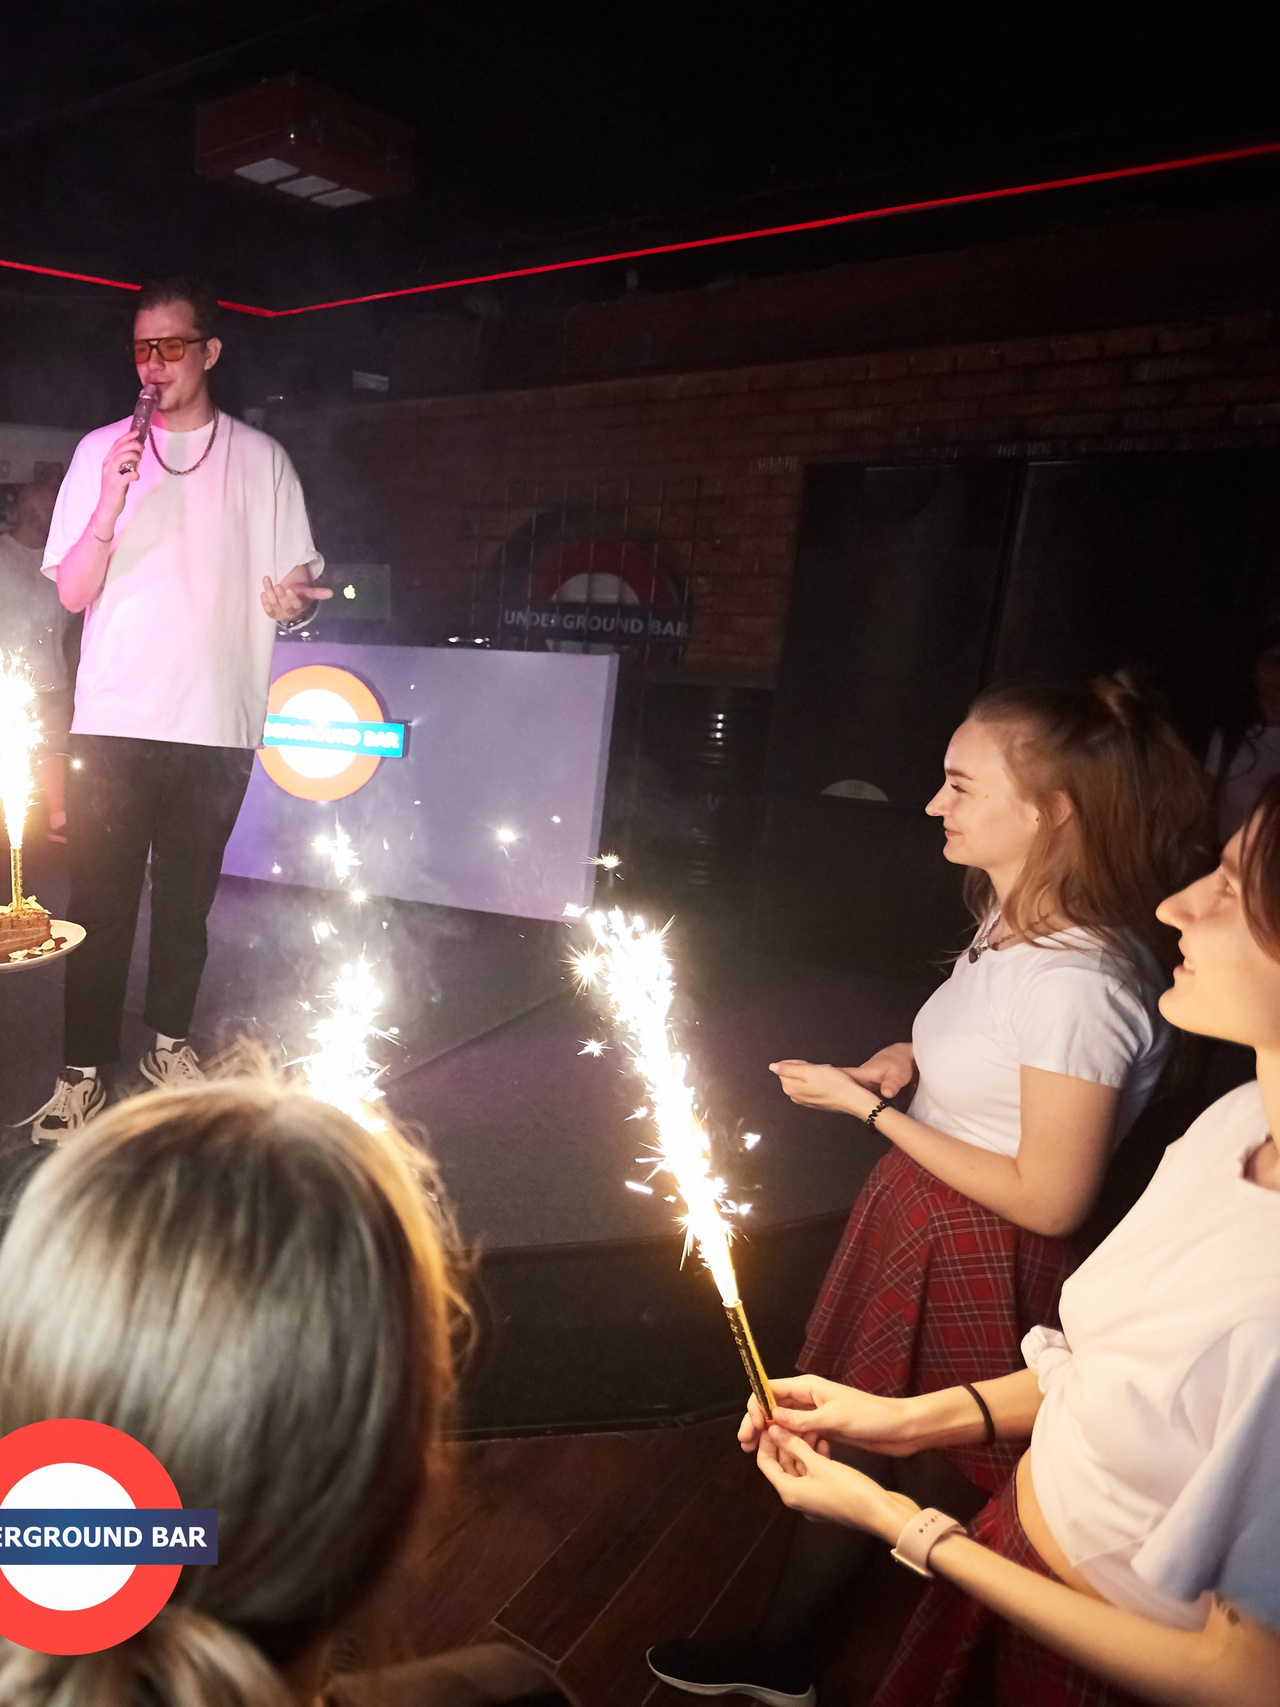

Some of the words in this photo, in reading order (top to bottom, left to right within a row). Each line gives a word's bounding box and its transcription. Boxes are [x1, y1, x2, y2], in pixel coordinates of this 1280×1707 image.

[503, 610, 644, 634] UNDERGROUND
[650, 619, 689, 637] BAR
[363, 730, 399, 749] BAR
